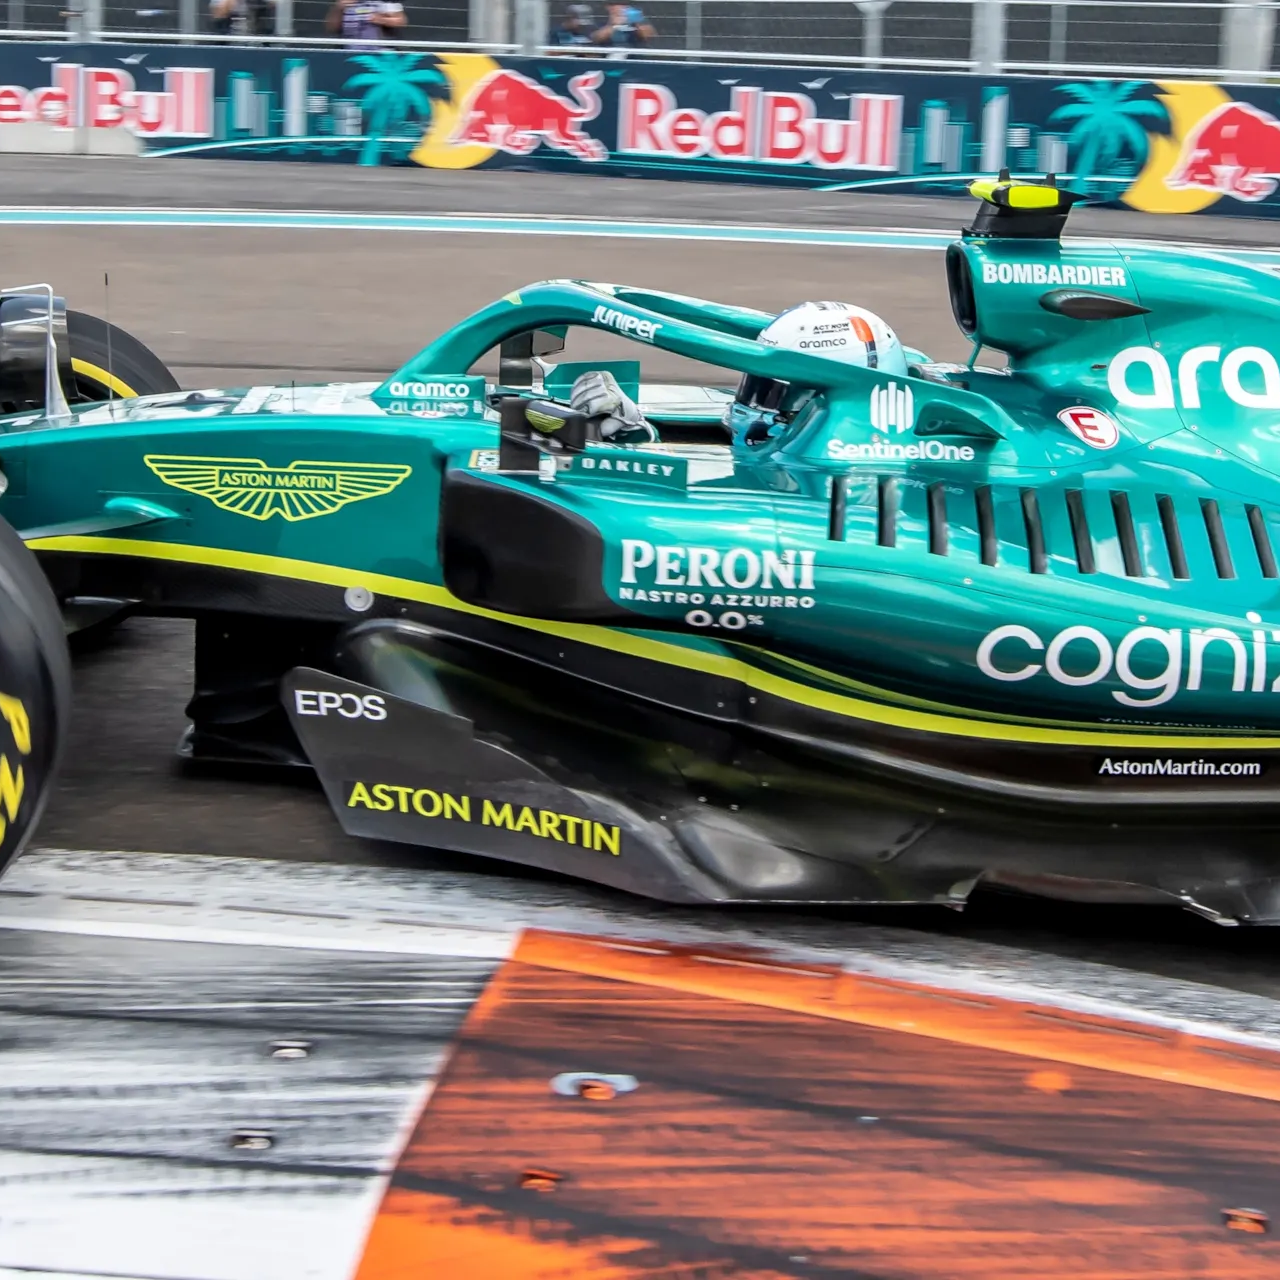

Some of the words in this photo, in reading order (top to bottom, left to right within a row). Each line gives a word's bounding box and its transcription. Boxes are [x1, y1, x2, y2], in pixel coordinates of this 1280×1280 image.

[983, 261, 1126, 288] BOMBARDIER
[799, 338, 847, 349] aramco
[389, 381, 470, 398] aramco
[1069, 413, 1106, 444] E
[827, 439, 975, 462] SentinelOne
[581, 456, 676, 478] OAKLEY
[220, 471, 272, 488] ASTON
[274, 473, 335, 490] MARTIN
[620, 538, 816, 590] PERONI
[619, 587, 706, 605] NASTRO
[710, 594, 816, 609] AZZURRO
[684, 609, 765, 631] 0.0%
[294, 689, 388, 721] EPOS
[1098, 757, 1261, 776] AstonMartin.com
[347, 781, 471, 823] ASTON
[481, 798, 621, 857] MARTIN
